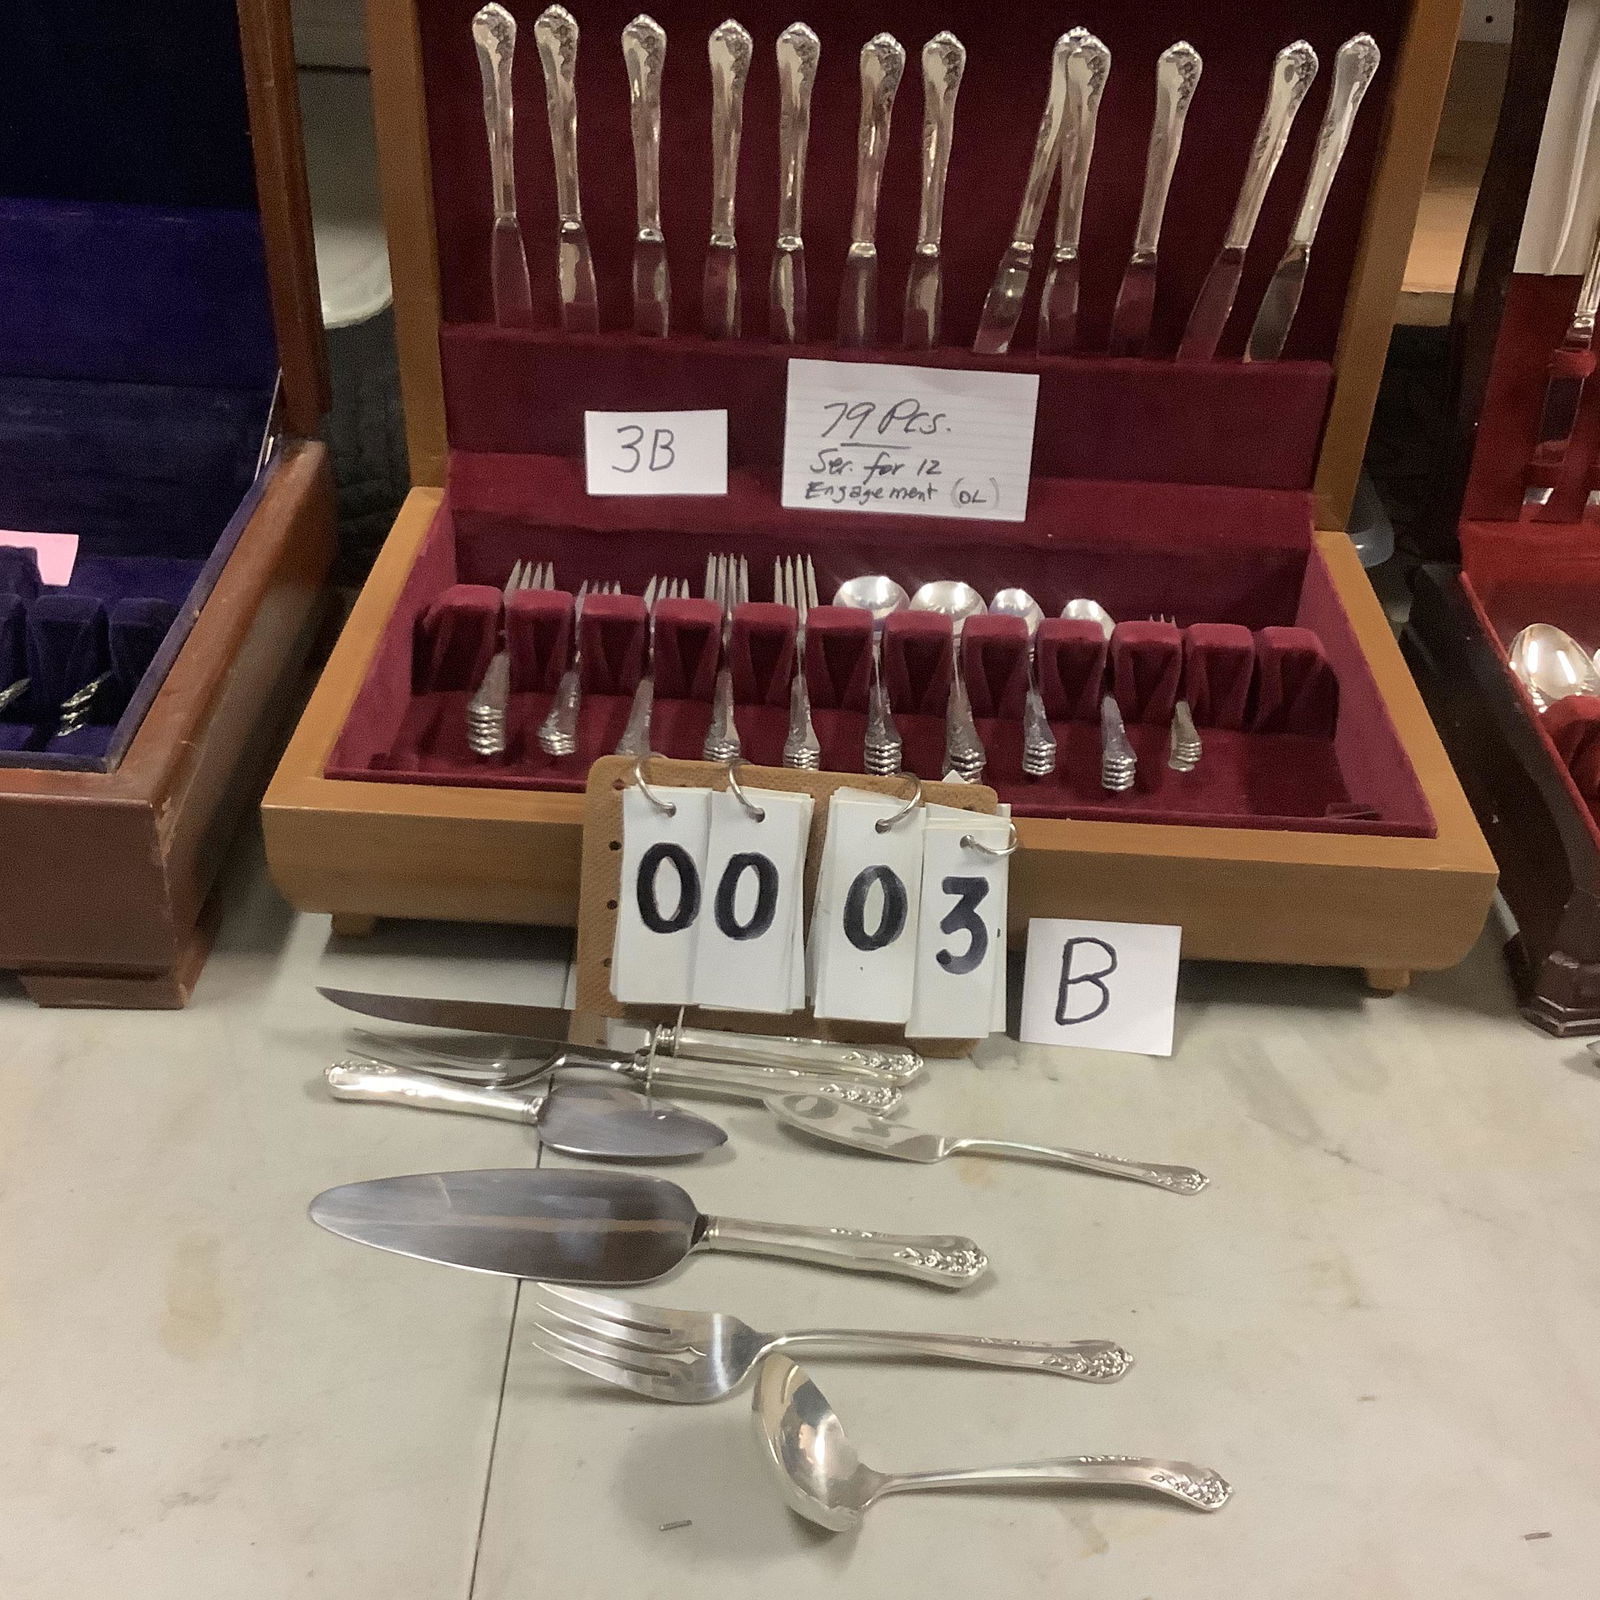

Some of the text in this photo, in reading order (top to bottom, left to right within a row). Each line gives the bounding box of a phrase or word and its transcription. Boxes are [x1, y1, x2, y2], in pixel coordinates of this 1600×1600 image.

[821, 401, 876, 439] 79
[612, 424, 676, 474] 3B
[809, 447, 942, 486] Ser. for 12
[804, 480, 938, 506] Engagement
[1054, 936, 1119, 1026] B
